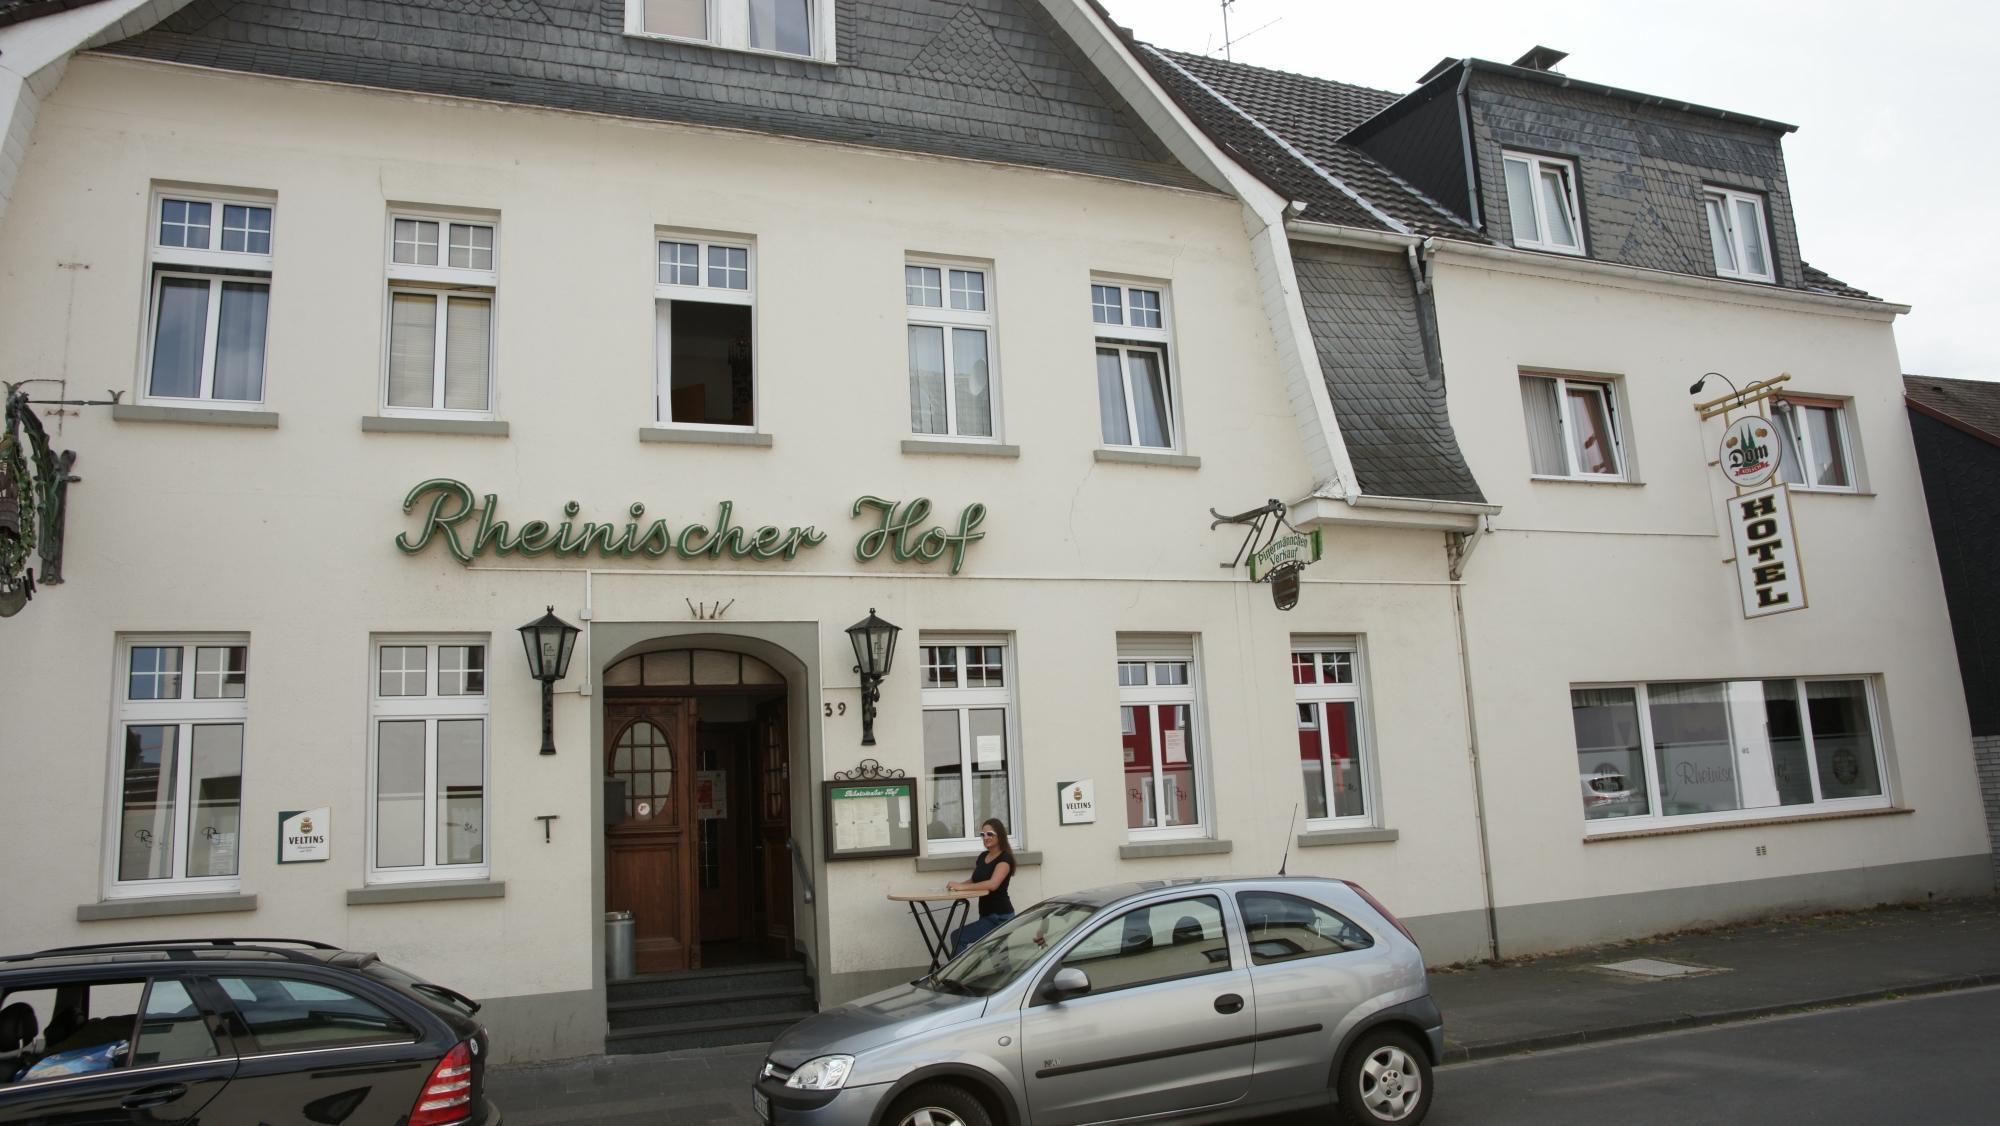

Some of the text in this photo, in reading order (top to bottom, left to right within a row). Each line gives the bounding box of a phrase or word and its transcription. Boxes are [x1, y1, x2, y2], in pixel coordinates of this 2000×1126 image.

[1729, 445, 1768, 469] Dom
[395, 478, 987, 576] Rheinischer Hof
[1270, 546, 1298, 565] Verkauf
[1741, 494, 1789, 608] HOTEL
[1066, 802, 1091, 810] VELTINS
[289, 836, 324, 845] VELTINS
